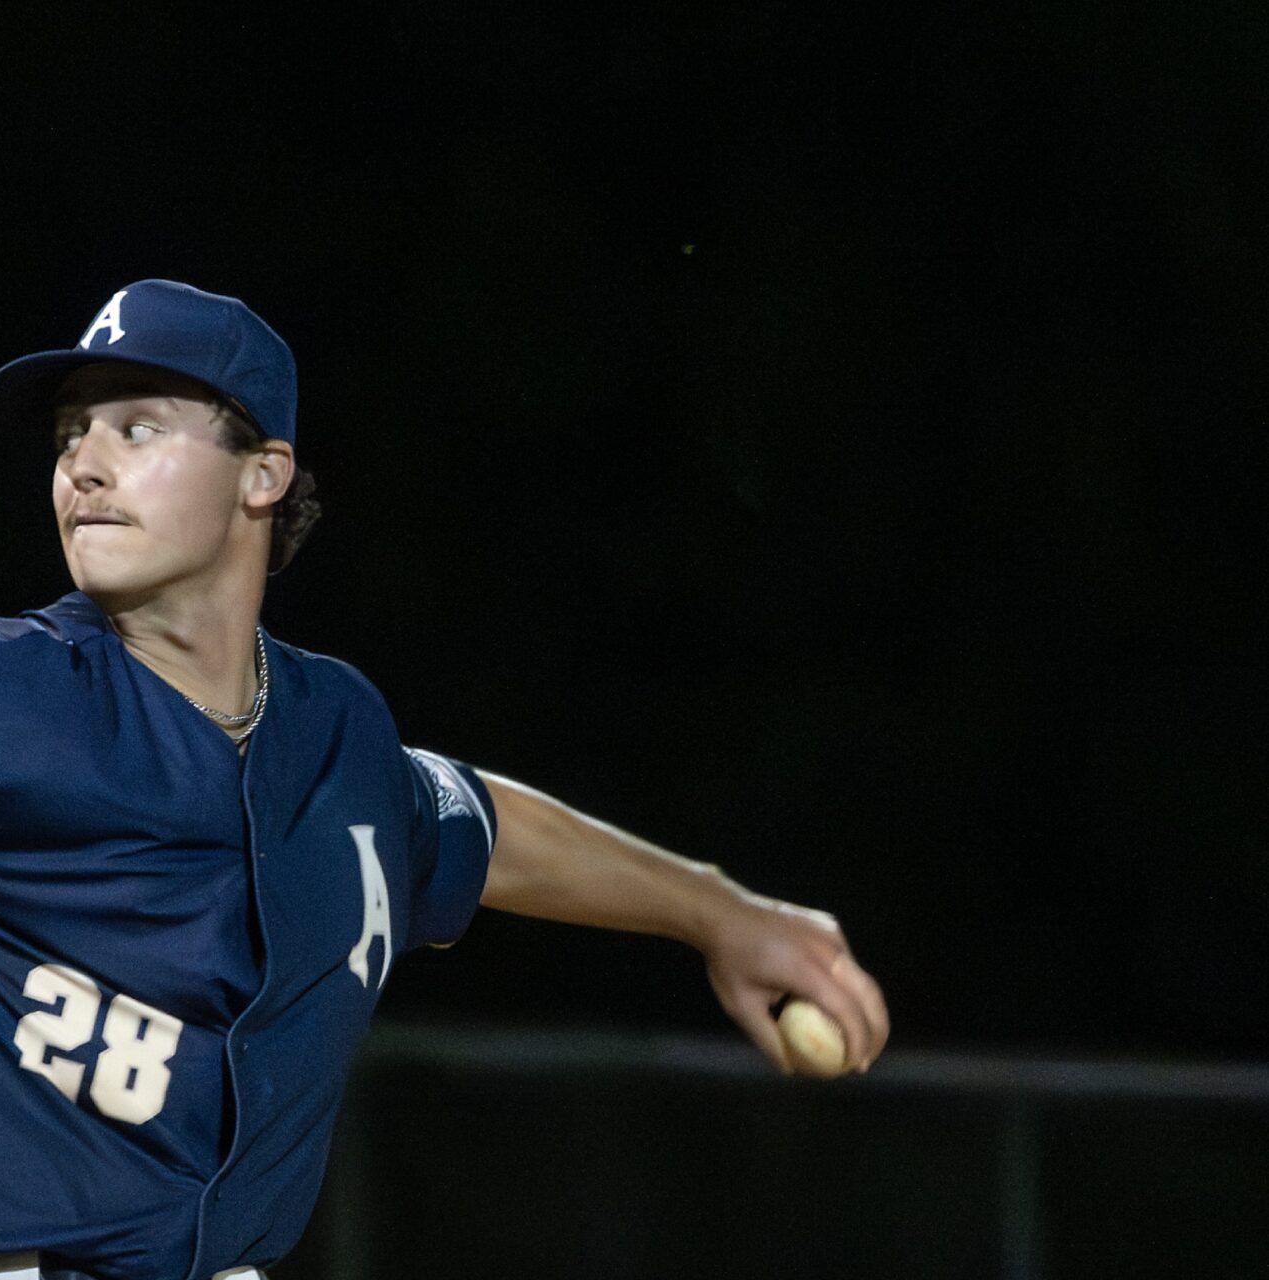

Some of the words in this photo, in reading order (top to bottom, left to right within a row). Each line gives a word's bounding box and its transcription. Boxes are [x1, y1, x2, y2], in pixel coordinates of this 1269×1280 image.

[81, 290, 128, 350] A
[347, 824, 392, 990] A
[13, 963, 184, 1126] 28
